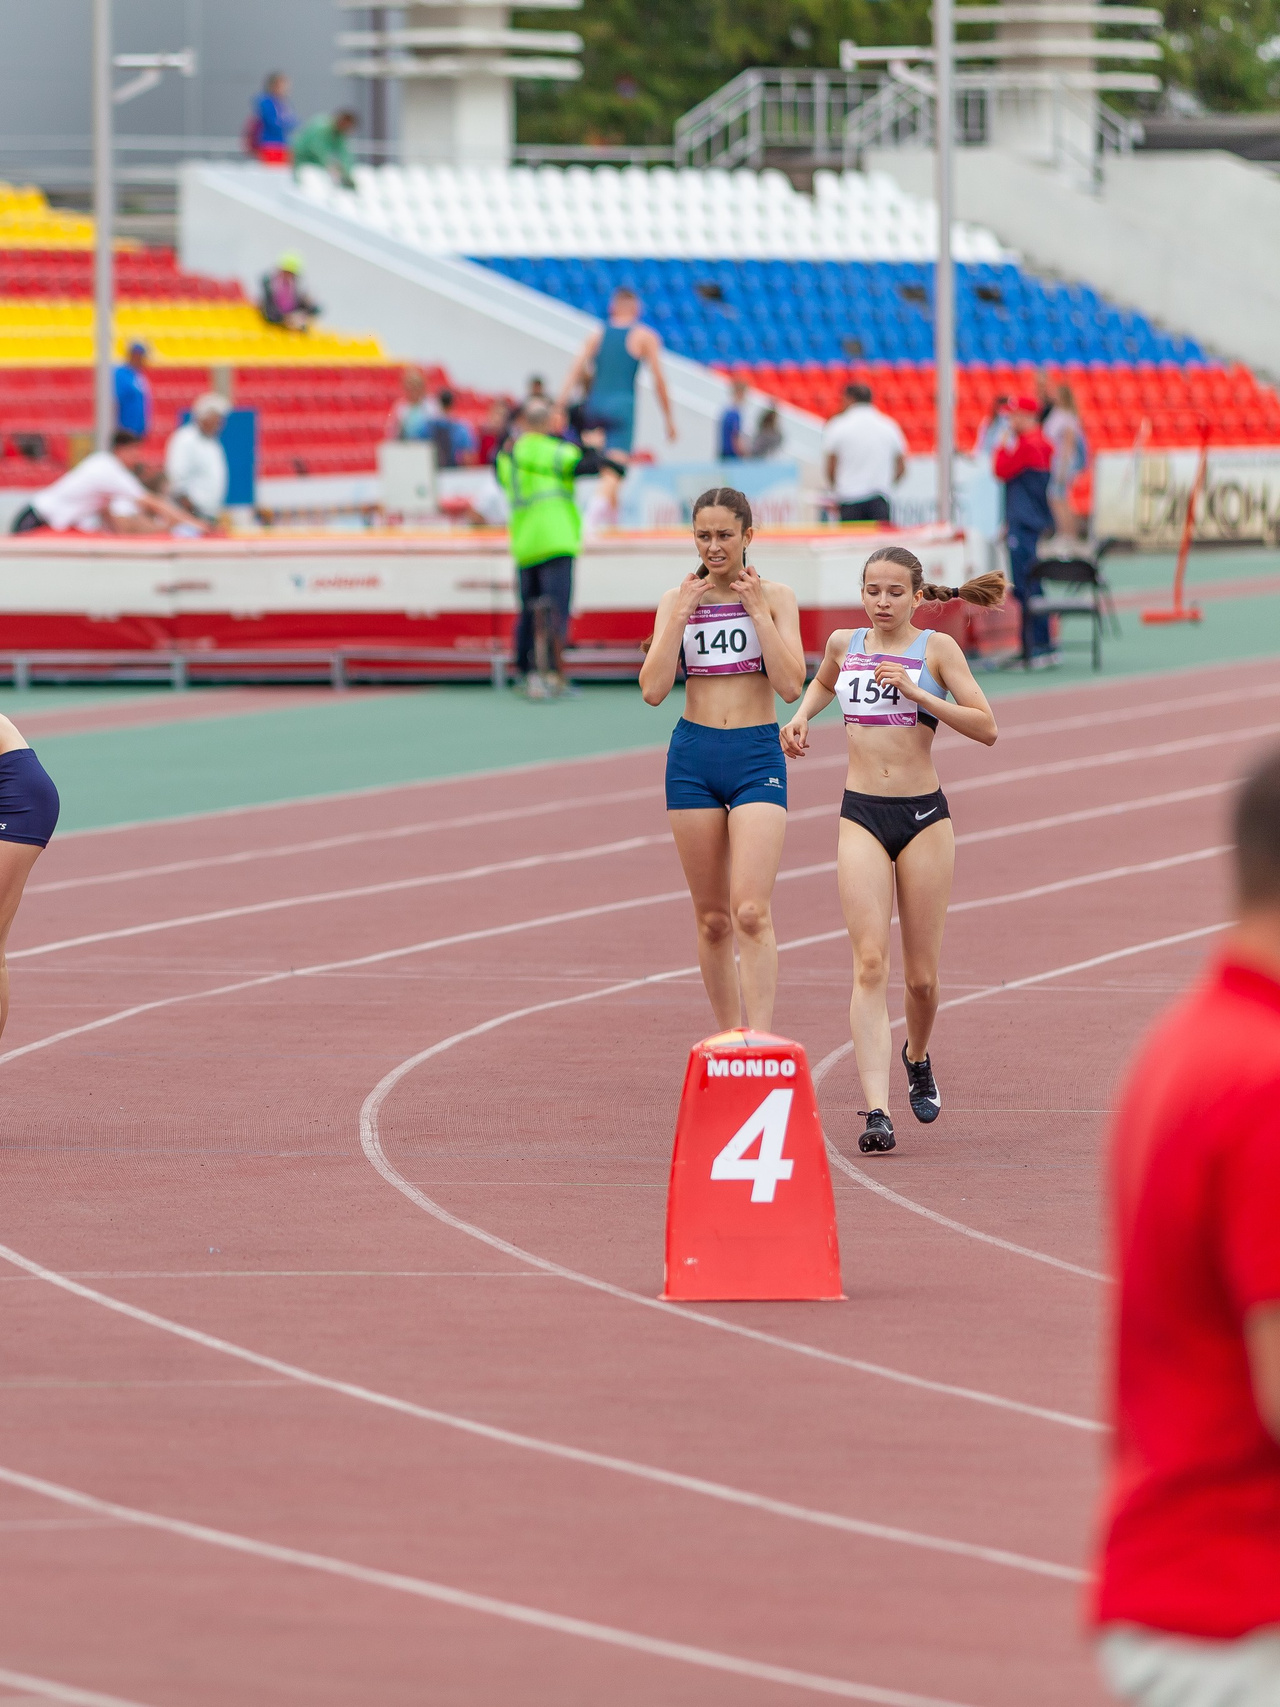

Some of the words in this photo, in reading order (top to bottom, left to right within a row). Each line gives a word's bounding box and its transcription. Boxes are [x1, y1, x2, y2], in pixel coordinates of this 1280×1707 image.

[694, 629, 747, 655] 140
[848, 677, 900, 706] 154
[707, 1059, 796, 1077] MONDO
[710, 1087, 795, 1203] 4
